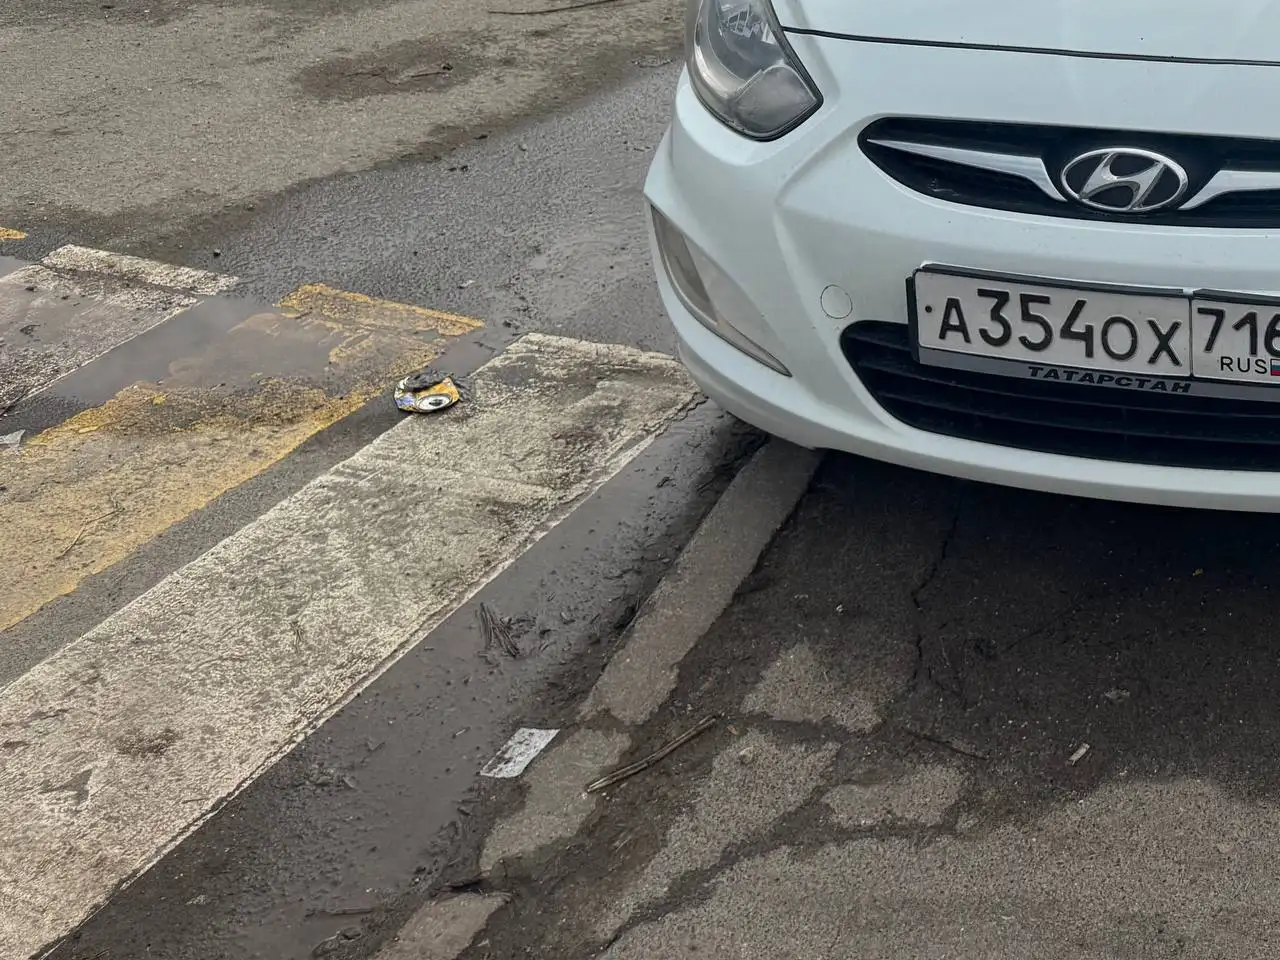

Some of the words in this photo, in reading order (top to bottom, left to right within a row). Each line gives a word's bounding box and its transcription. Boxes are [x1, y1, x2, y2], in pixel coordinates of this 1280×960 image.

[938, 288, 1183, 367] А354ОХ
[1220, 356, 1268, 375] RUS
[1028, 366, 1192, 394] ТАТАРСТАН
